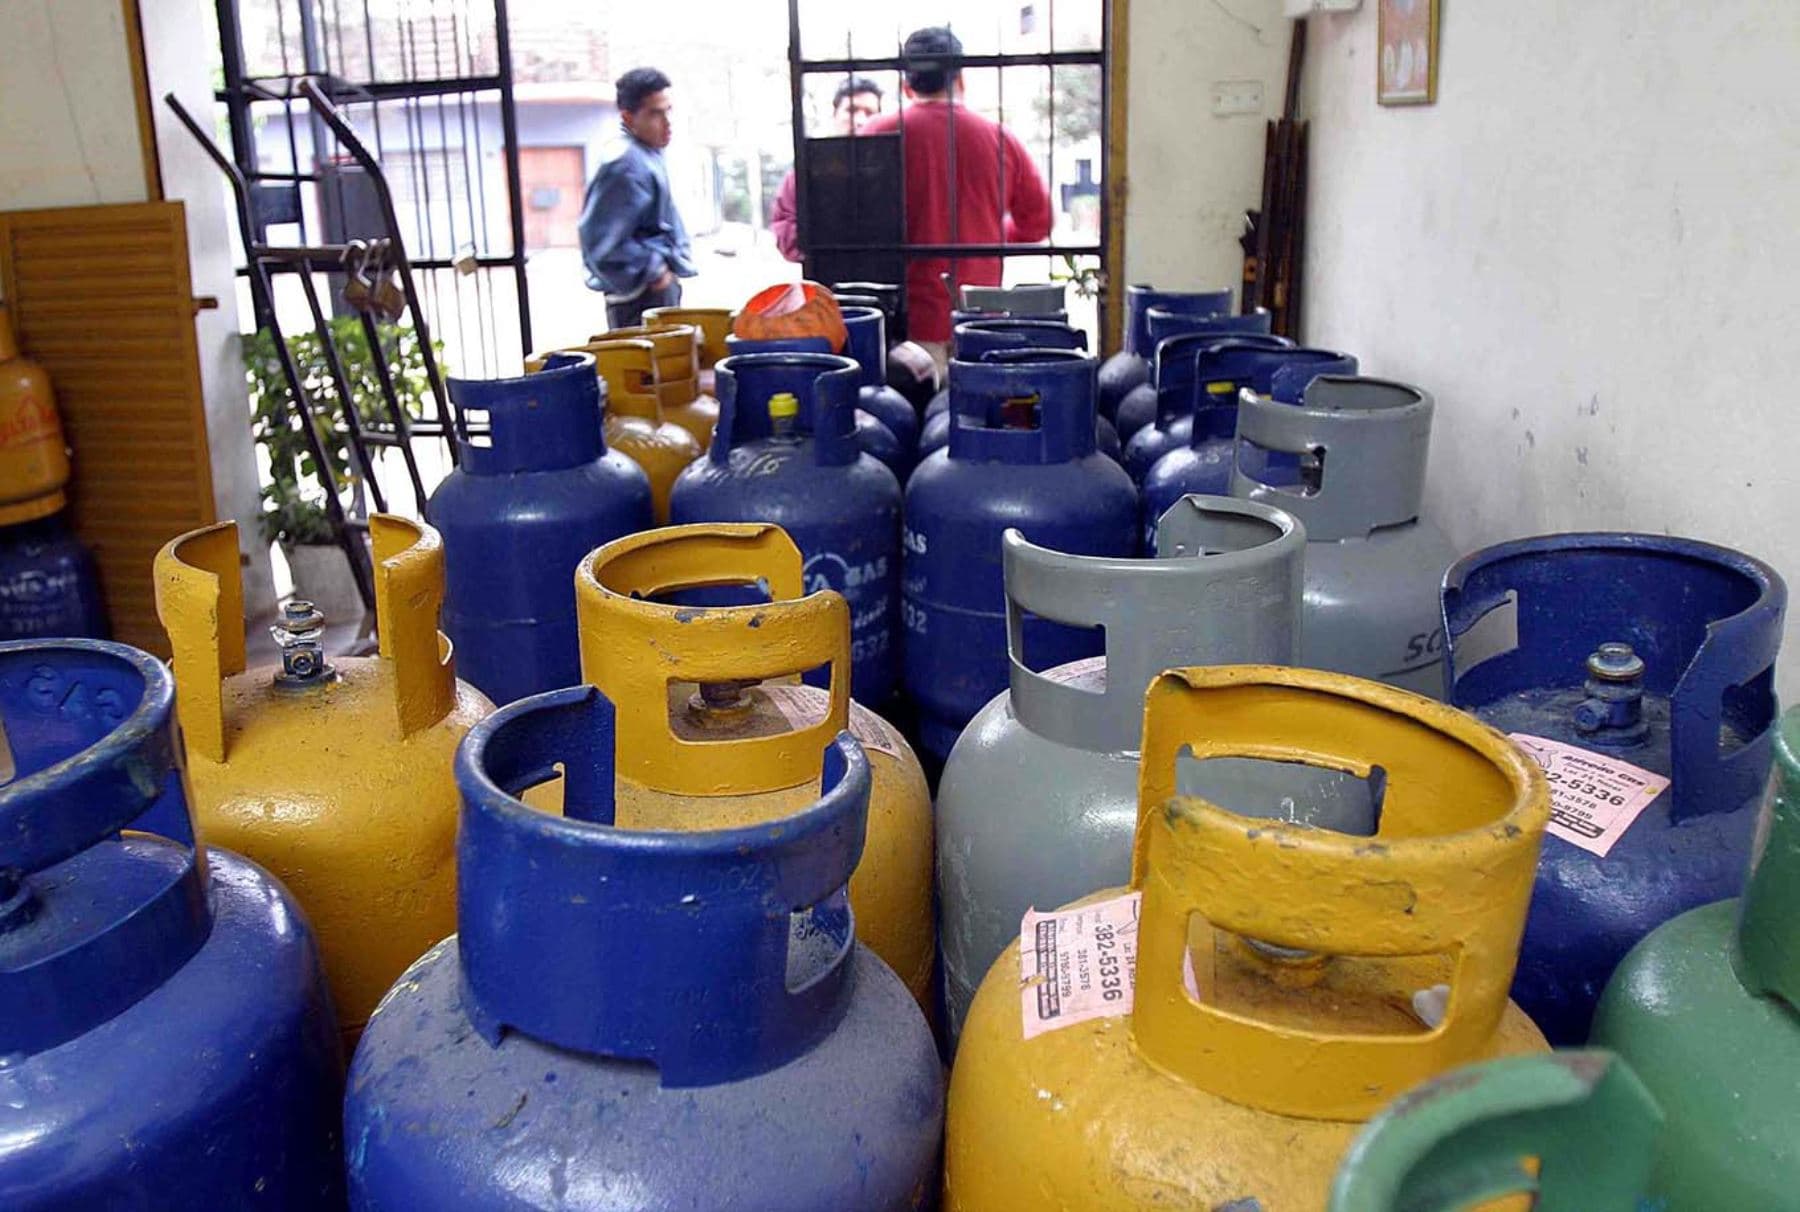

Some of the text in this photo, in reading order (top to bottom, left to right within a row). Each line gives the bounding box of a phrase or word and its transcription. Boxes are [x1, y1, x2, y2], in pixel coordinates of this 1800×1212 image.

[902, 525, 927, 554] AS
[1542, 770, 1625, 806] 2-5336
[1095, 924, 1123, 1002] 382-5336
